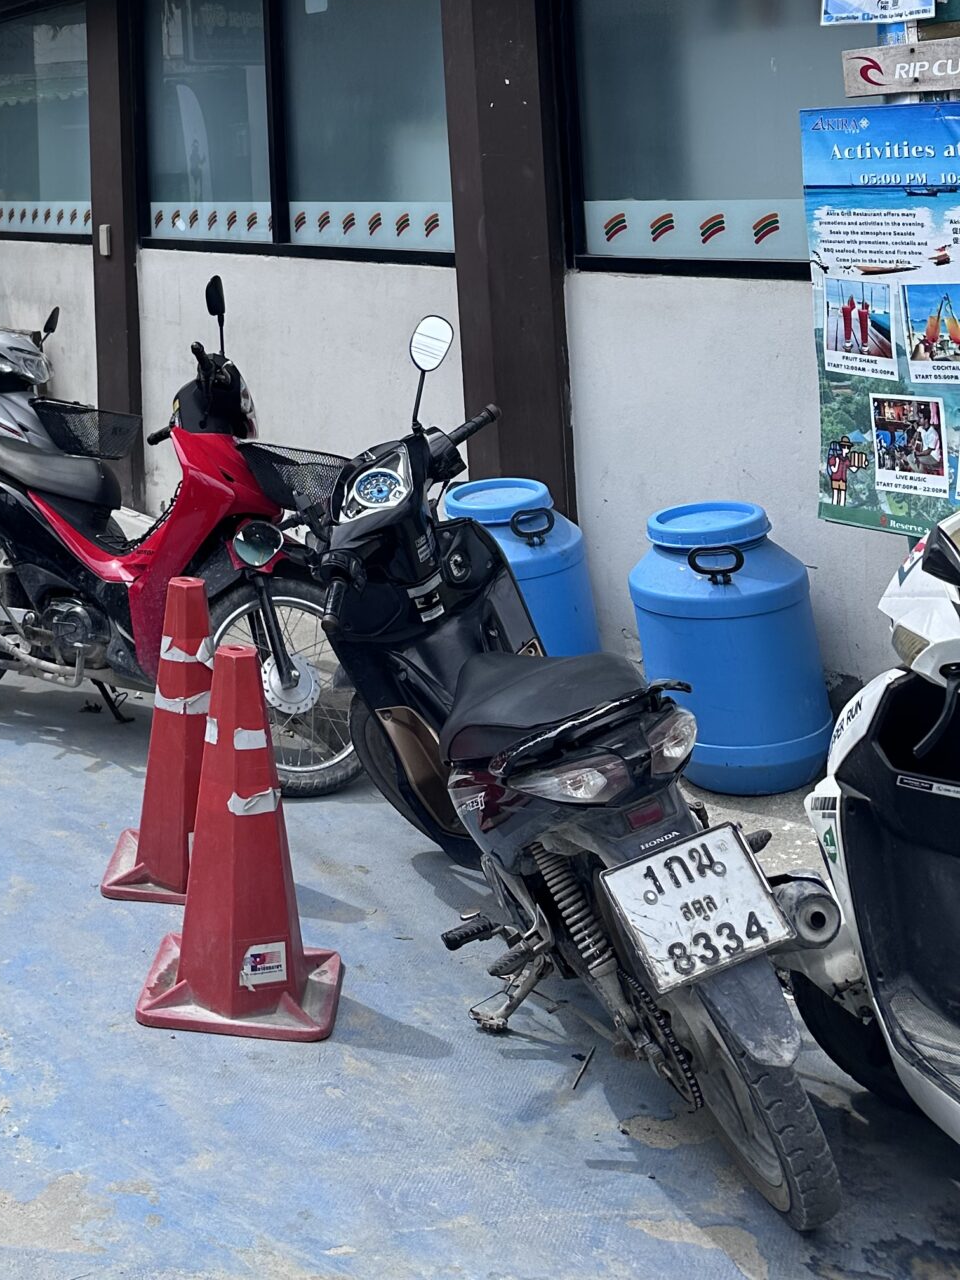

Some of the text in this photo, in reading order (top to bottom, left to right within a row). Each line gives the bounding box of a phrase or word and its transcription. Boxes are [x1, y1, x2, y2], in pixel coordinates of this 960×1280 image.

[894, 60, 929, 80] RIP
[811, 116, 859, 131] AKIRA
[831, 141, 936, 160] Activities
[860, 172, 902, 185] 05:00
[906, 172, 928, 185] PM
[858, 357, 878, 365] SHAKE
[890, 519, 923, 531] Reserve
[846, 696, 863, 726] RUN
[640, 830, 680, 851] HONDA
[679, 894, 719, 922] สตูล
[667, 910, 770, 976] 8334
